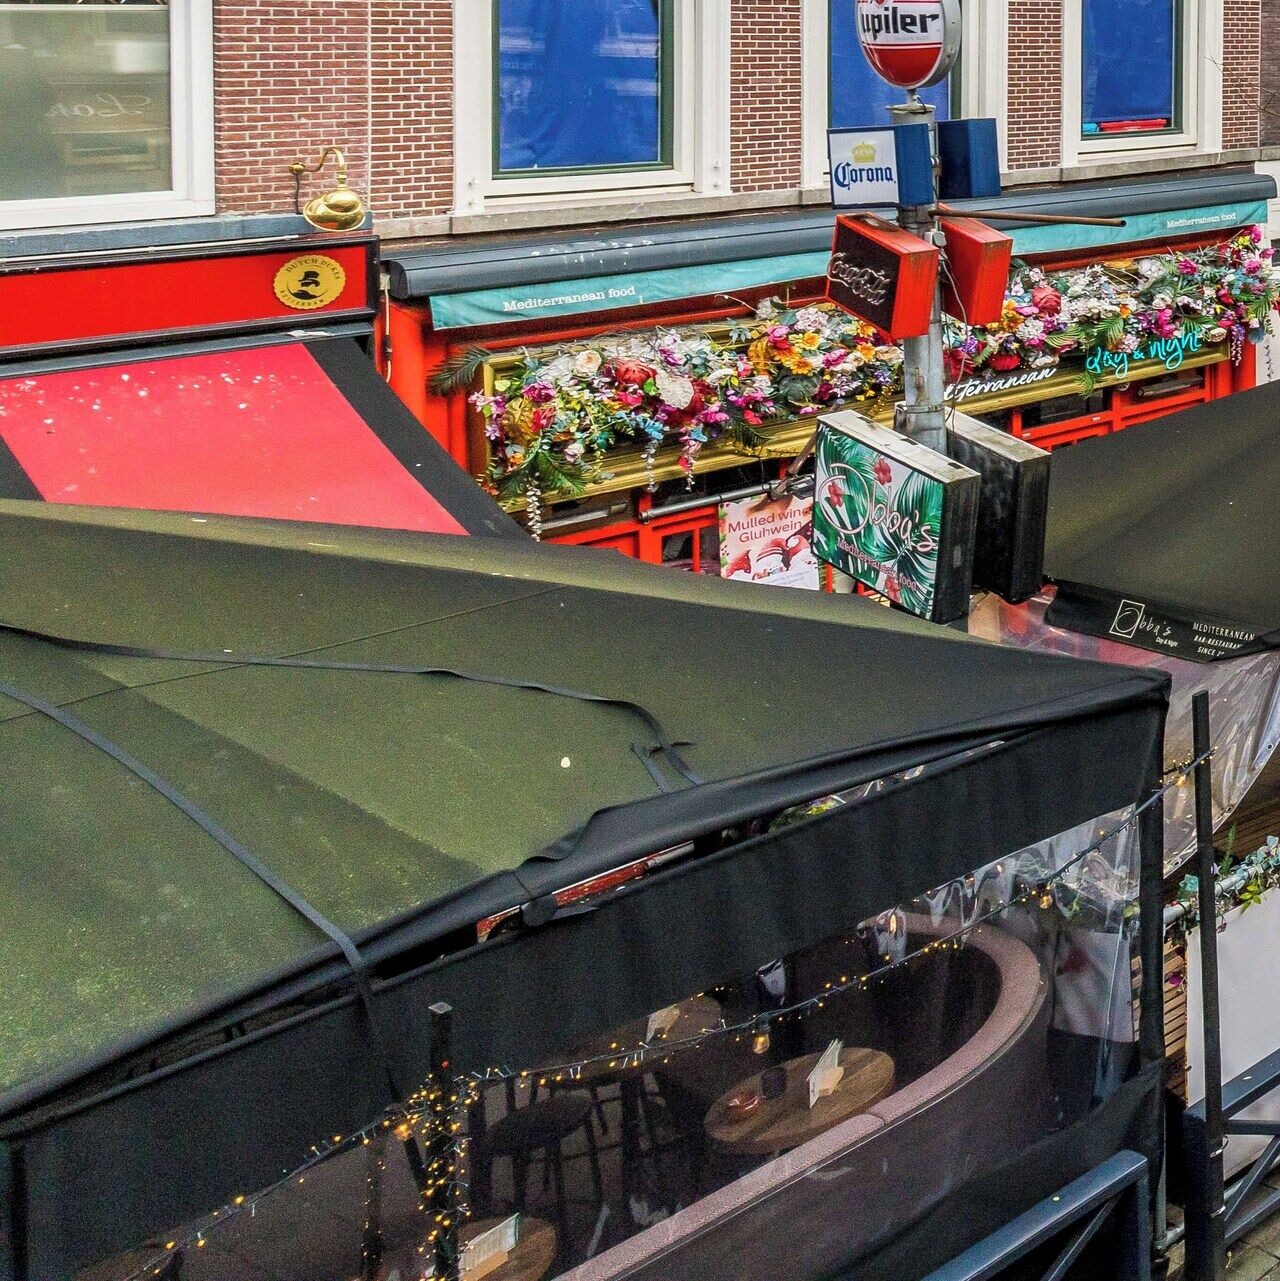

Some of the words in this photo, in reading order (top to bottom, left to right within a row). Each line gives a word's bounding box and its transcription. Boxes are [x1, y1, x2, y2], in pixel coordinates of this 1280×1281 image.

[857, 6, 940, 41] upiler
[834, 162, 896, 191] Corona
[1166, 215, 1220, 229] Mediterranean
[1221, 212, 1237, 221] food
[285, 258, 318, 273] DUTCH
[503, 290, 606, 312] Mediterranean
[608, 285, 637, 298] food
[728, 513, 776, 534] Mulled
[738, 520, 802, 544] Gluhwein
[1192, 622, 1255, 641] MEDITERRANEAN
[1194, 634, 1243, 650] BAR-RESTAURAN
[1197, 646, 1216, 656] SINCE
